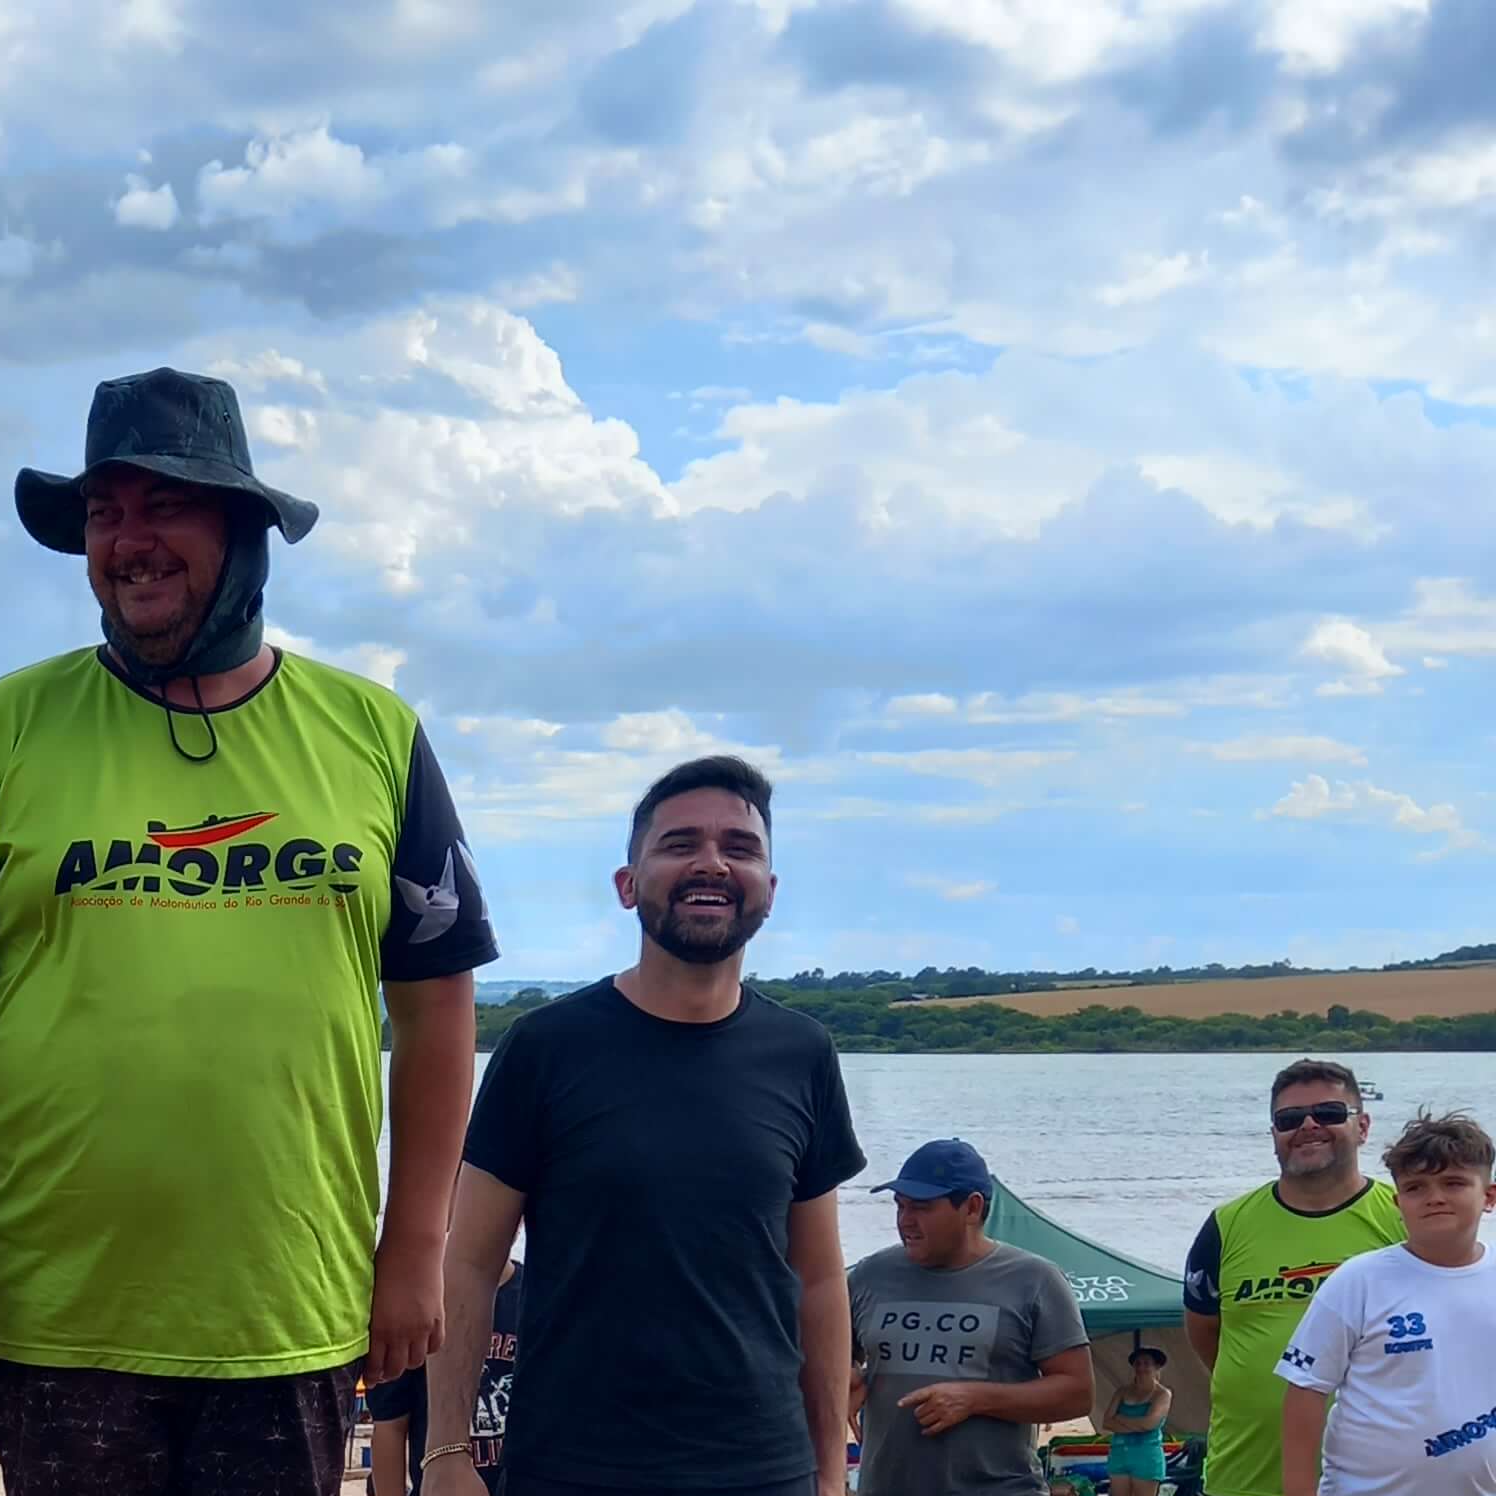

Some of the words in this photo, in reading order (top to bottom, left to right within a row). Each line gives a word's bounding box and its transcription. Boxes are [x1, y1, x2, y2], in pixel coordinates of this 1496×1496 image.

[55, 838, 363, 896] AMORGS
[130, 896, 144, 908] de
[223, 897, 239, 909] do
[245, 895, 263, 907] Rio
[269, 893, 312, 906] Grande
[880, 1311, 981, 1333] PG.CO
[1386, 1311, 1427, 1339] 33
[878, 1341, 977, 1365] SURF
